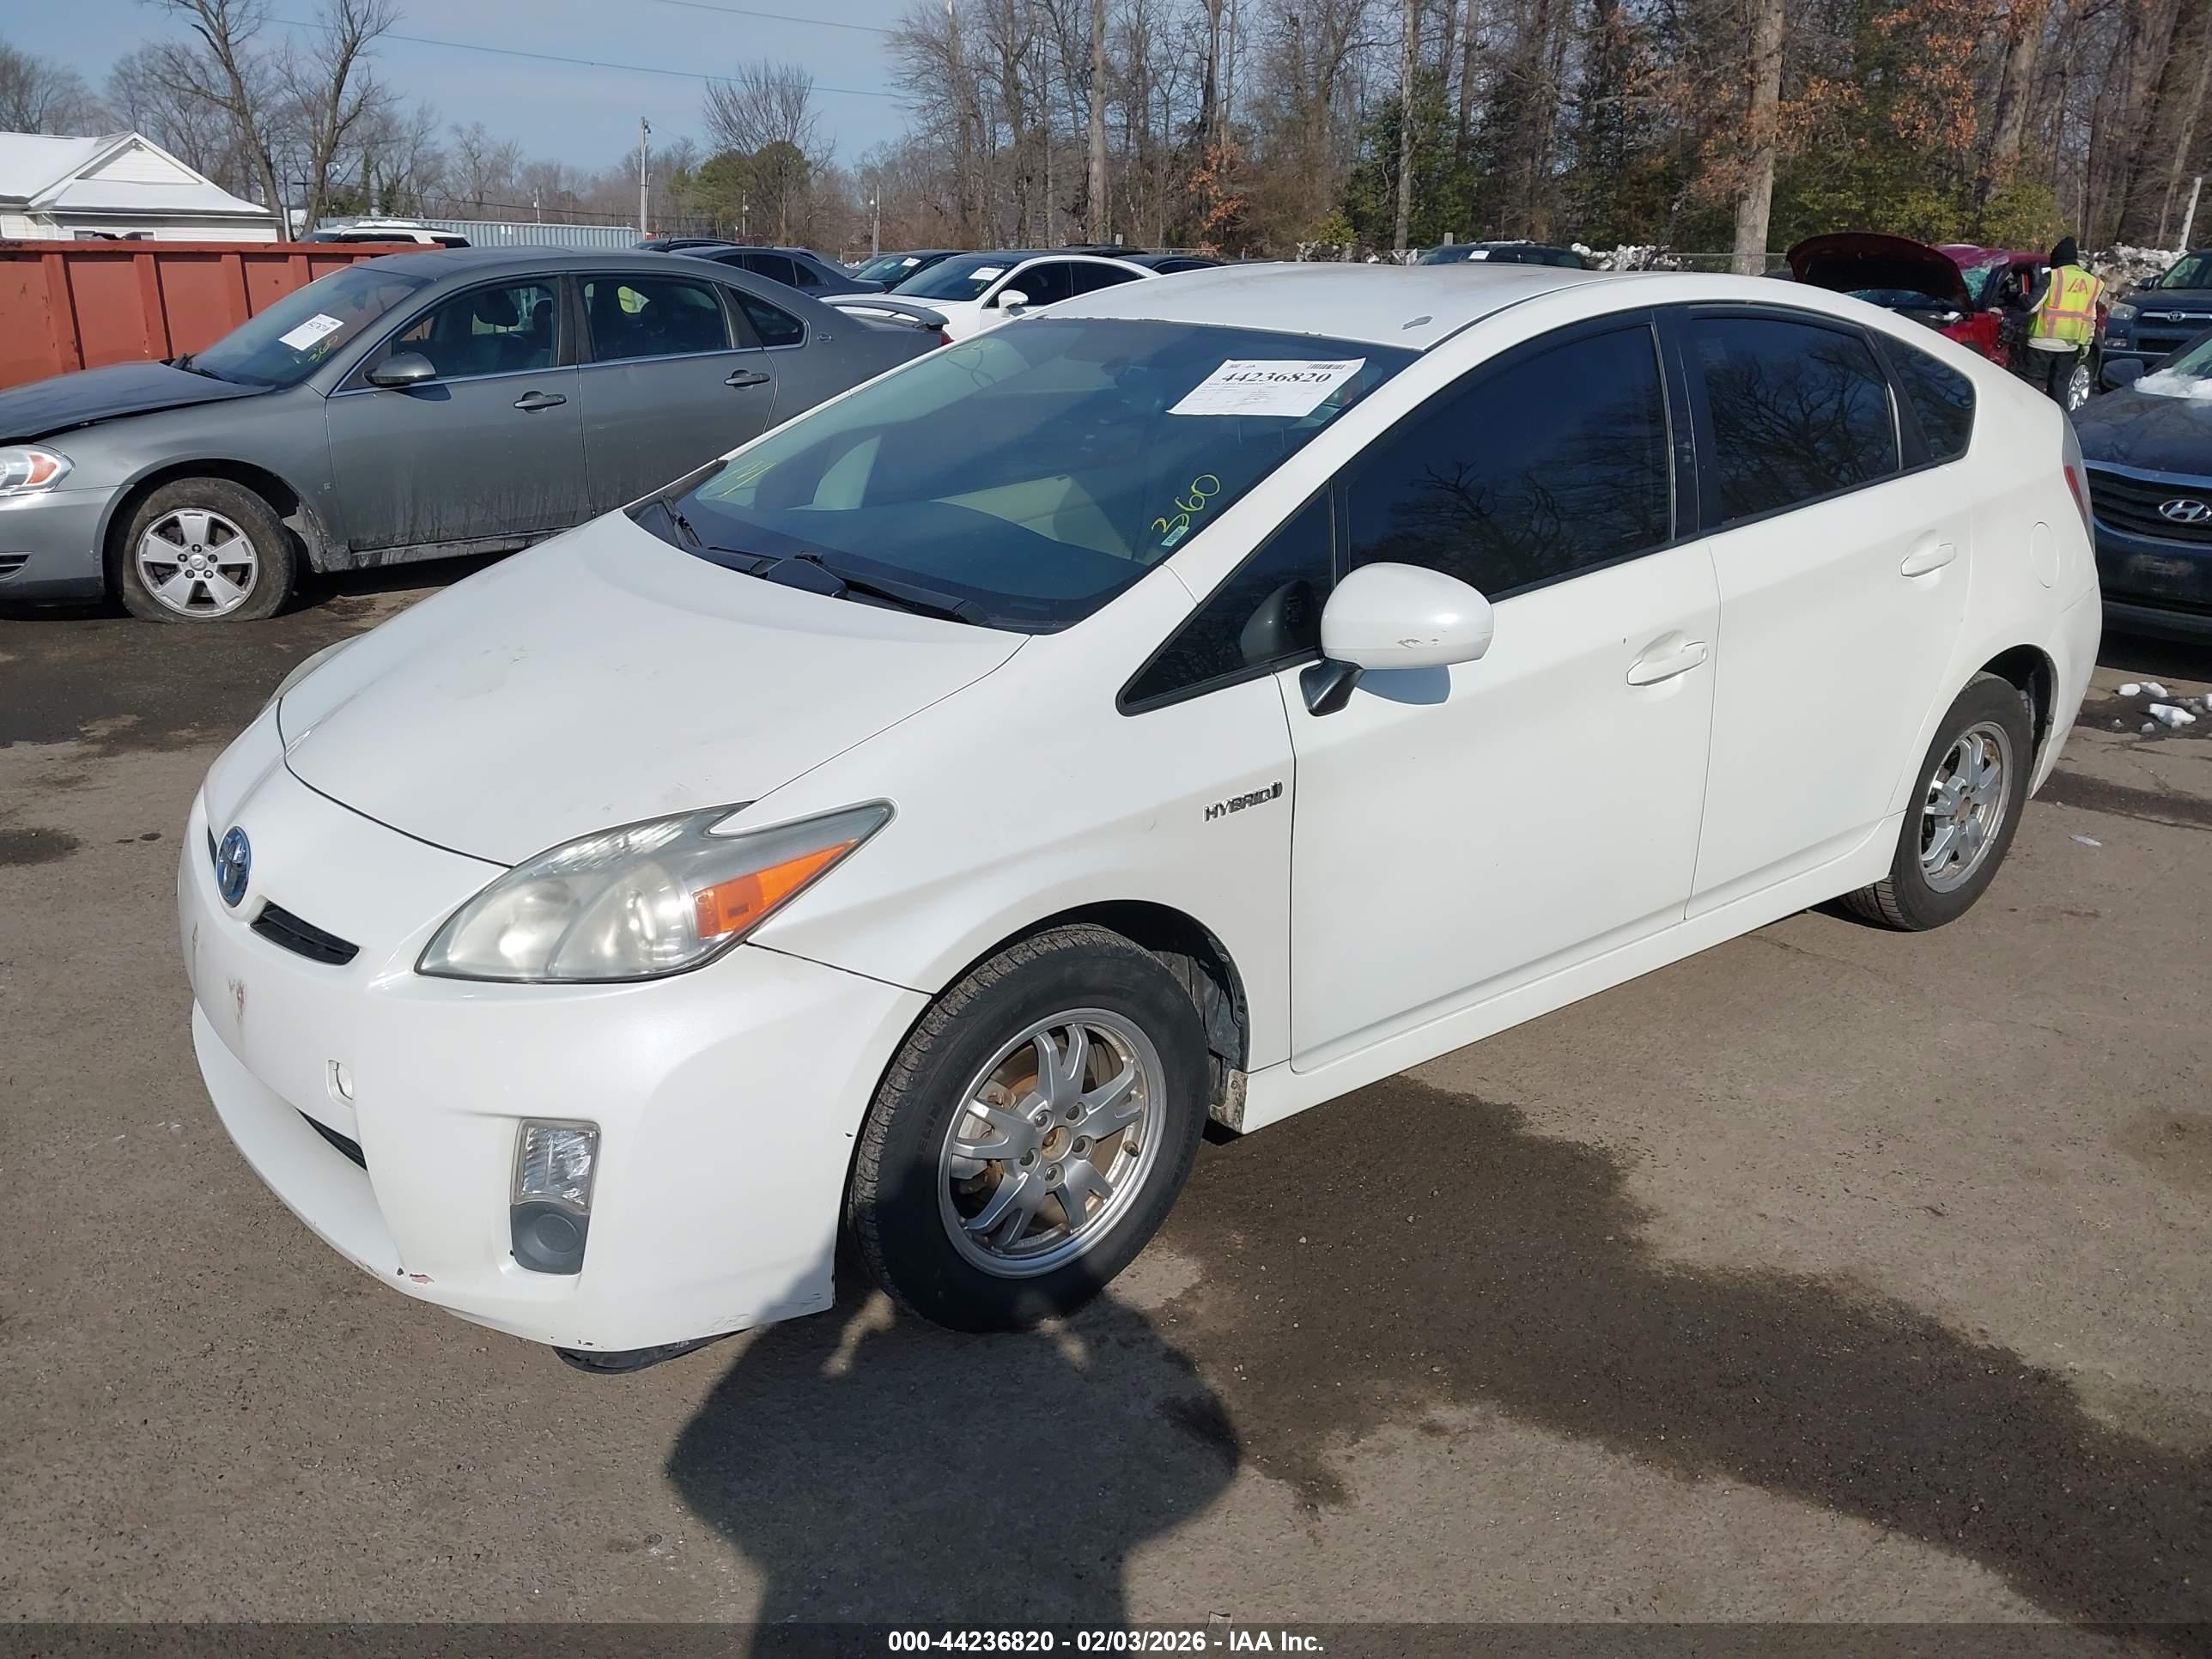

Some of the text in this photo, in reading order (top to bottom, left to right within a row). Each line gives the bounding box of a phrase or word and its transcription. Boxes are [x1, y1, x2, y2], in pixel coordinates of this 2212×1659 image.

[1220, 372, 1332, 383] 44236820
[1151, 473, 1220, 533] 360
[1203, 787, 1272, 822] HYBRID
